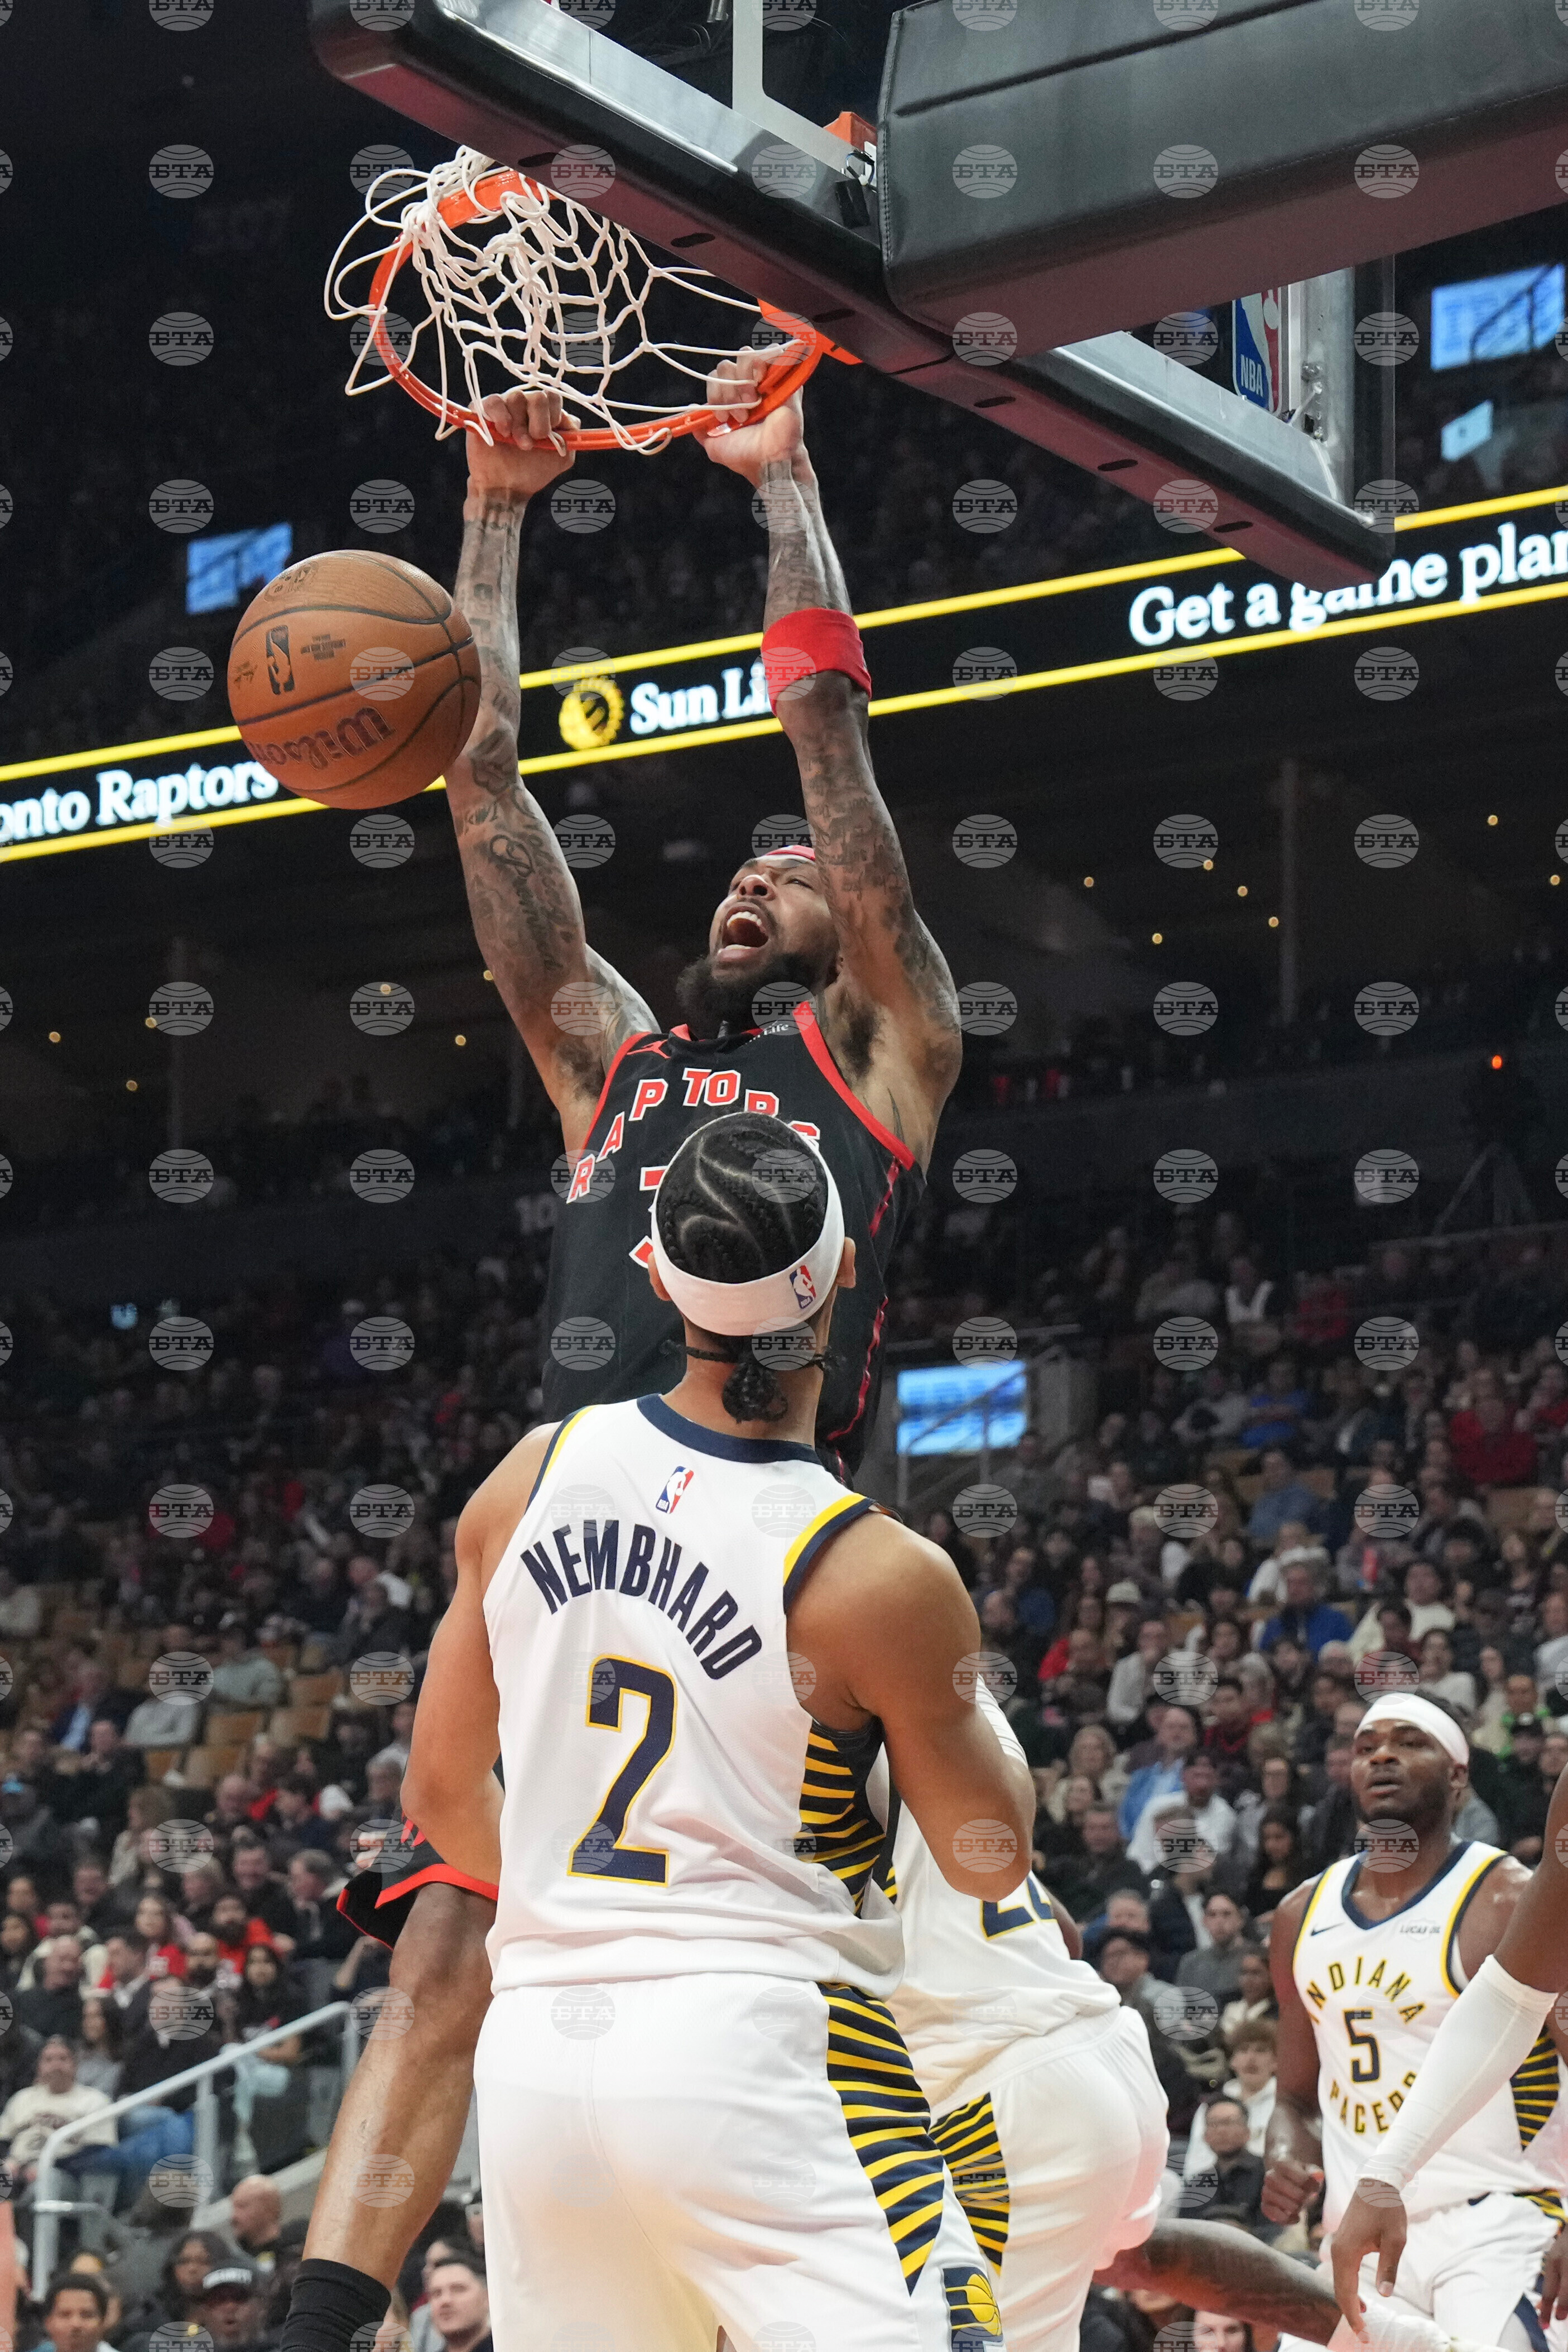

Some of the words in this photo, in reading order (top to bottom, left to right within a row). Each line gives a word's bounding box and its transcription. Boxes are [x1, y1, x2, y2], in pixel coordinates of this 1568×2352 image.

[1240, 354, 1263, 397] NBA
[1129, 582, 1235, 646] Get
[1245, 583, 1281, 628] a
[1289, 553, 1449, 632] game
[630, 682, 719, 735] Sun
[722, 663, 772, 719] Li
[248, 705, 397, 771] Wilson
[95, 761, 278, 828] Raptors
[520, 1520, 762, 1680] NEMBHARD
[567, 1654, 677, 1888] 2
[1306, 1956, 1426, 2025] INDIANA
[1342, 2007, 1381, 2084] 5
